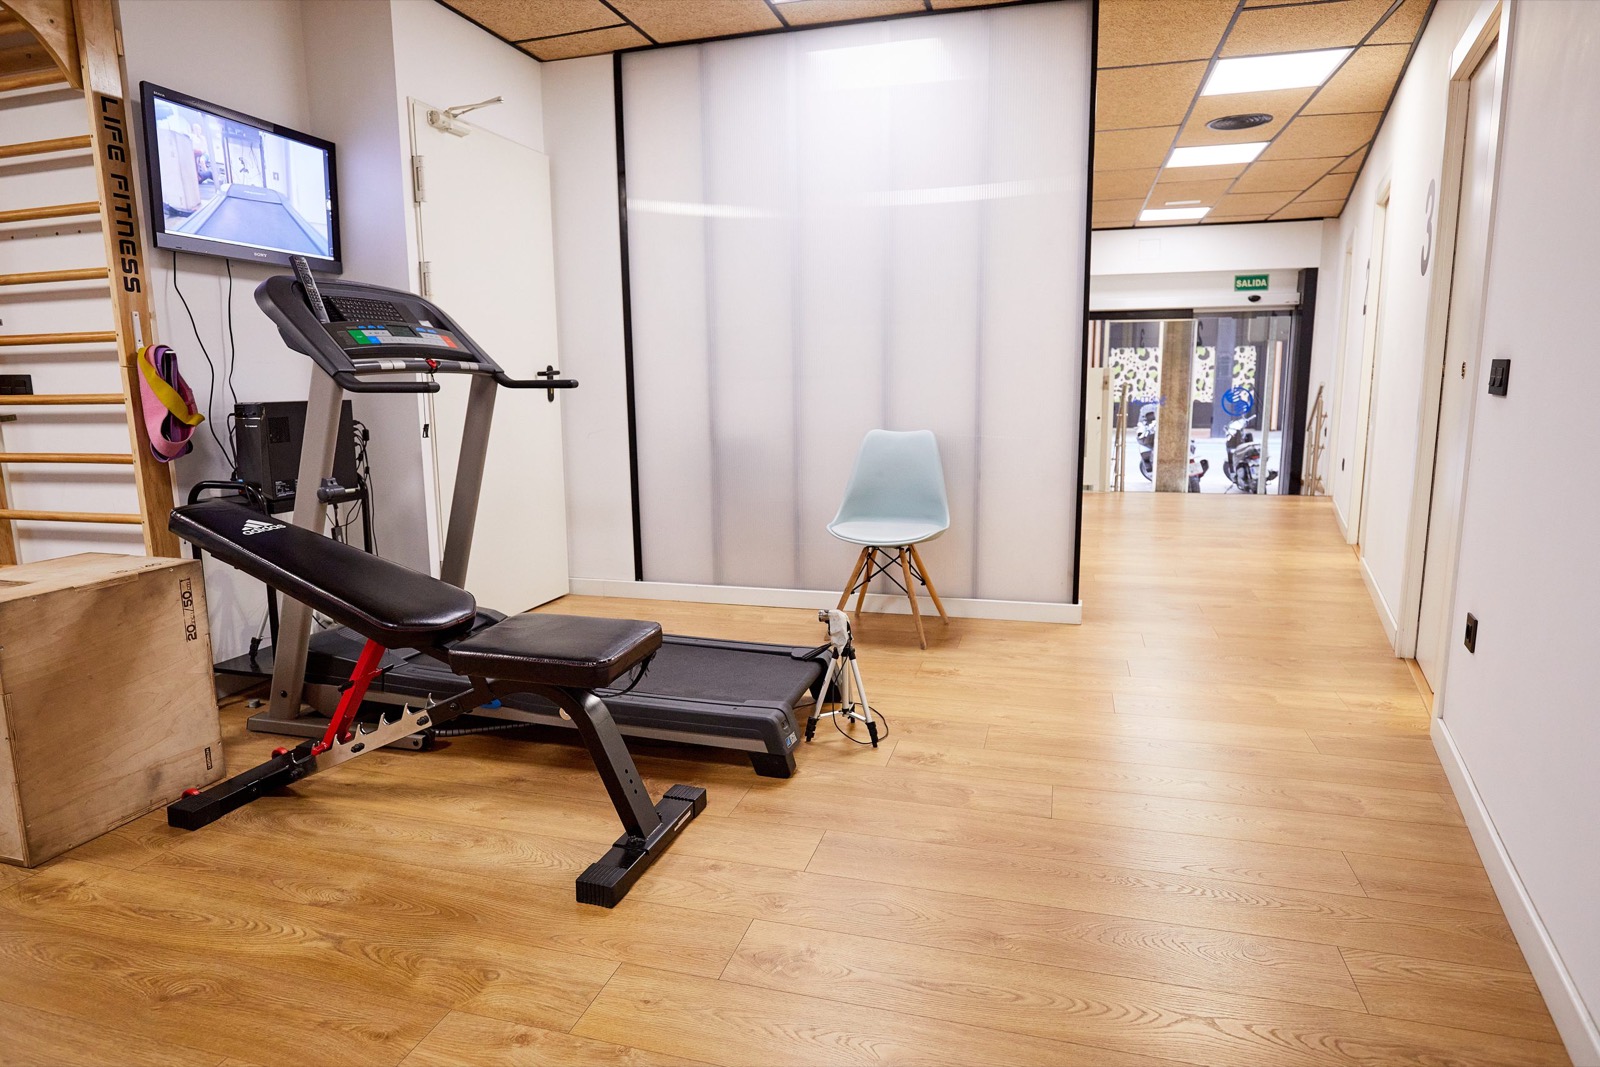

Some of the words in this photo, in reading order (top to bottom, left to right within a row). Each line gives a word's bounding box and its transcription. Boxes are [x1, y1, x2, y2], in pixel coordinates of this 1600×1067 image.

[100, 95, 126, 164] LIFE
[110, 172, 141, 294] FITNESS
[1420, 178, 1436, 277] 3
[1236, 278, 1267, 288] SALIDA
[242, 524, 287, 536] adidas
